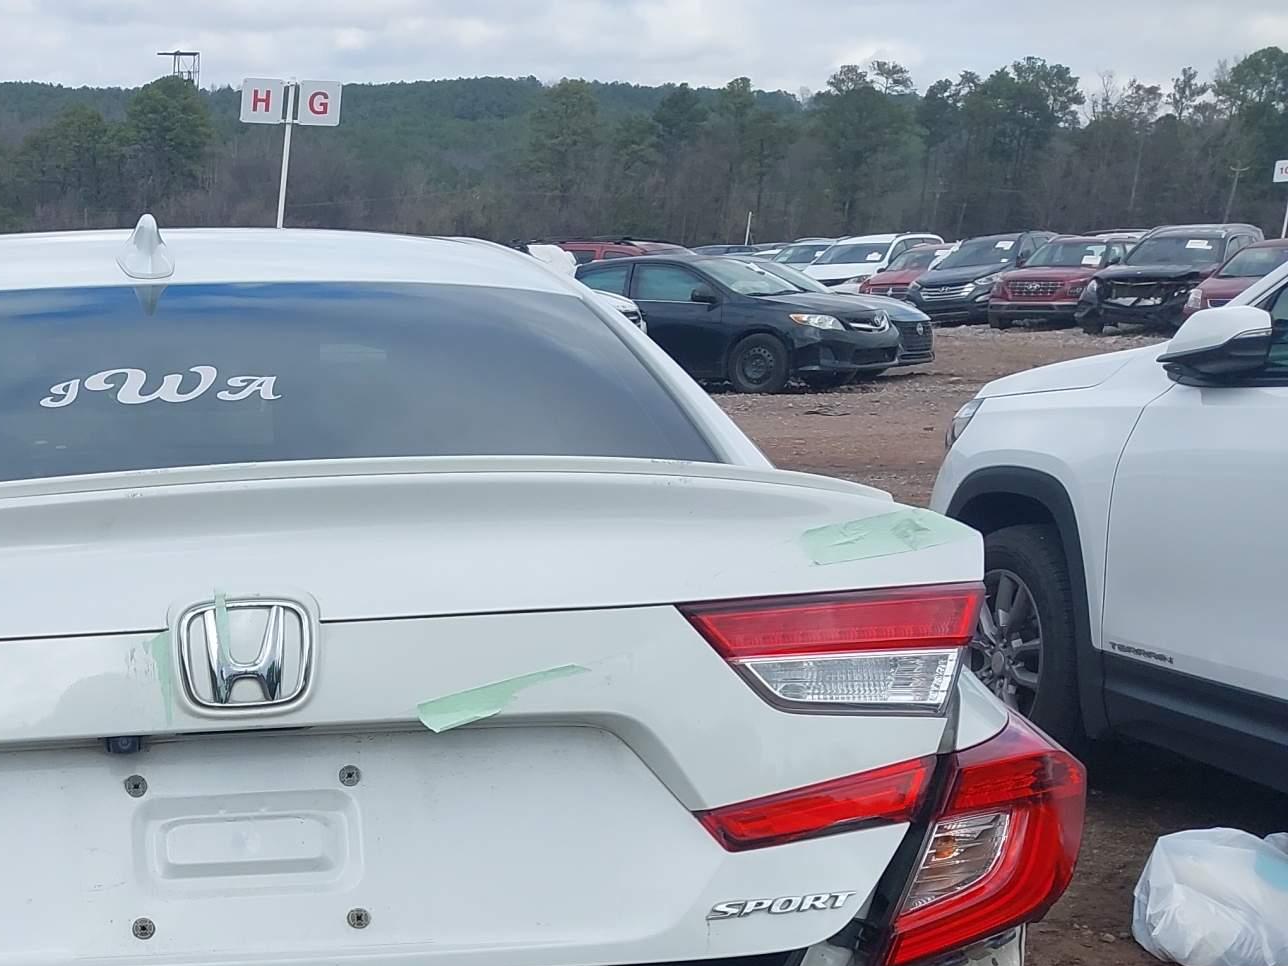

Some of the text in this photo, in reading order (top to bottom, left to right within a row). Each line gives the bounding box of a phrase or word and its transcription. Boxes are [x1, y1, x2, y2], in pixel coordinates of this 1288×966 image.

[252, 89, 271, 112] H
[308, 91, 329, 115] G
[705, 890, 856, 921] SPORT
